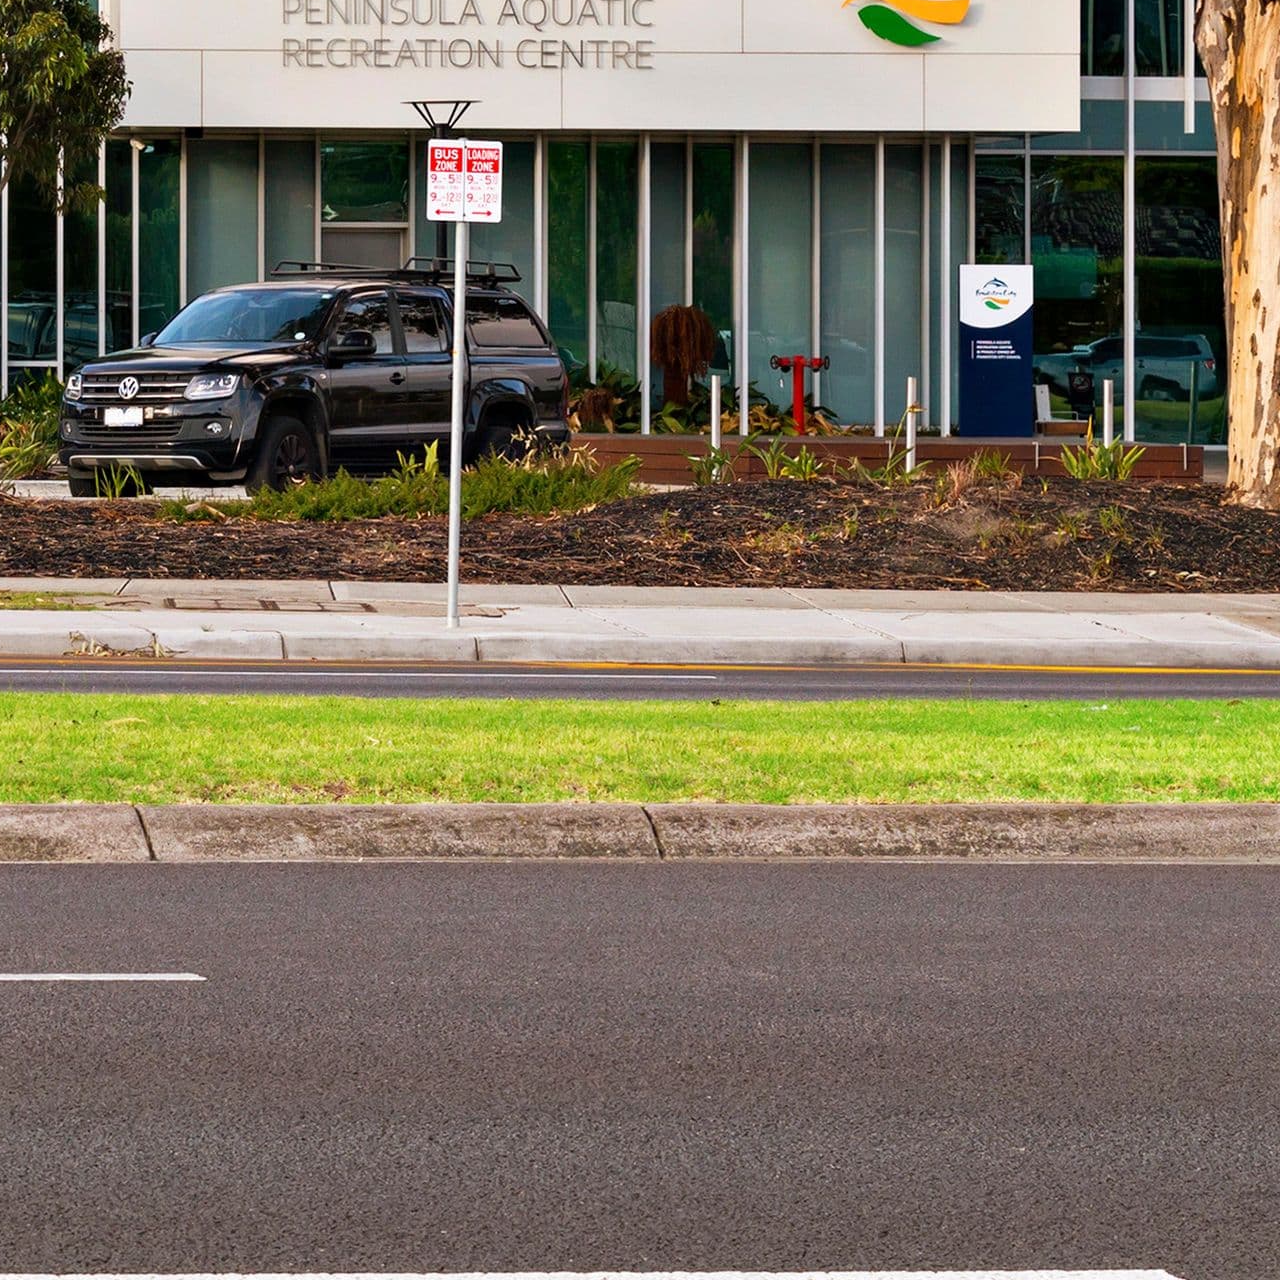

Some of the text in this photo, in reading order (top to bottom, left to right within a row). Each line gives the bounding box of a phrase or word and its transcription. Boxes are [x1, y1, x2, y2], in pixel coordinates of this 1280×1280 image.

[281, 38, 655, 70] RECREATION CENTRE
[434, 148, 459, 160] BUS
[467, 149, 499, 160] LOADING
[435, 161, 458, 171] ZONE
[471, 161, 494, 172] ZONE
